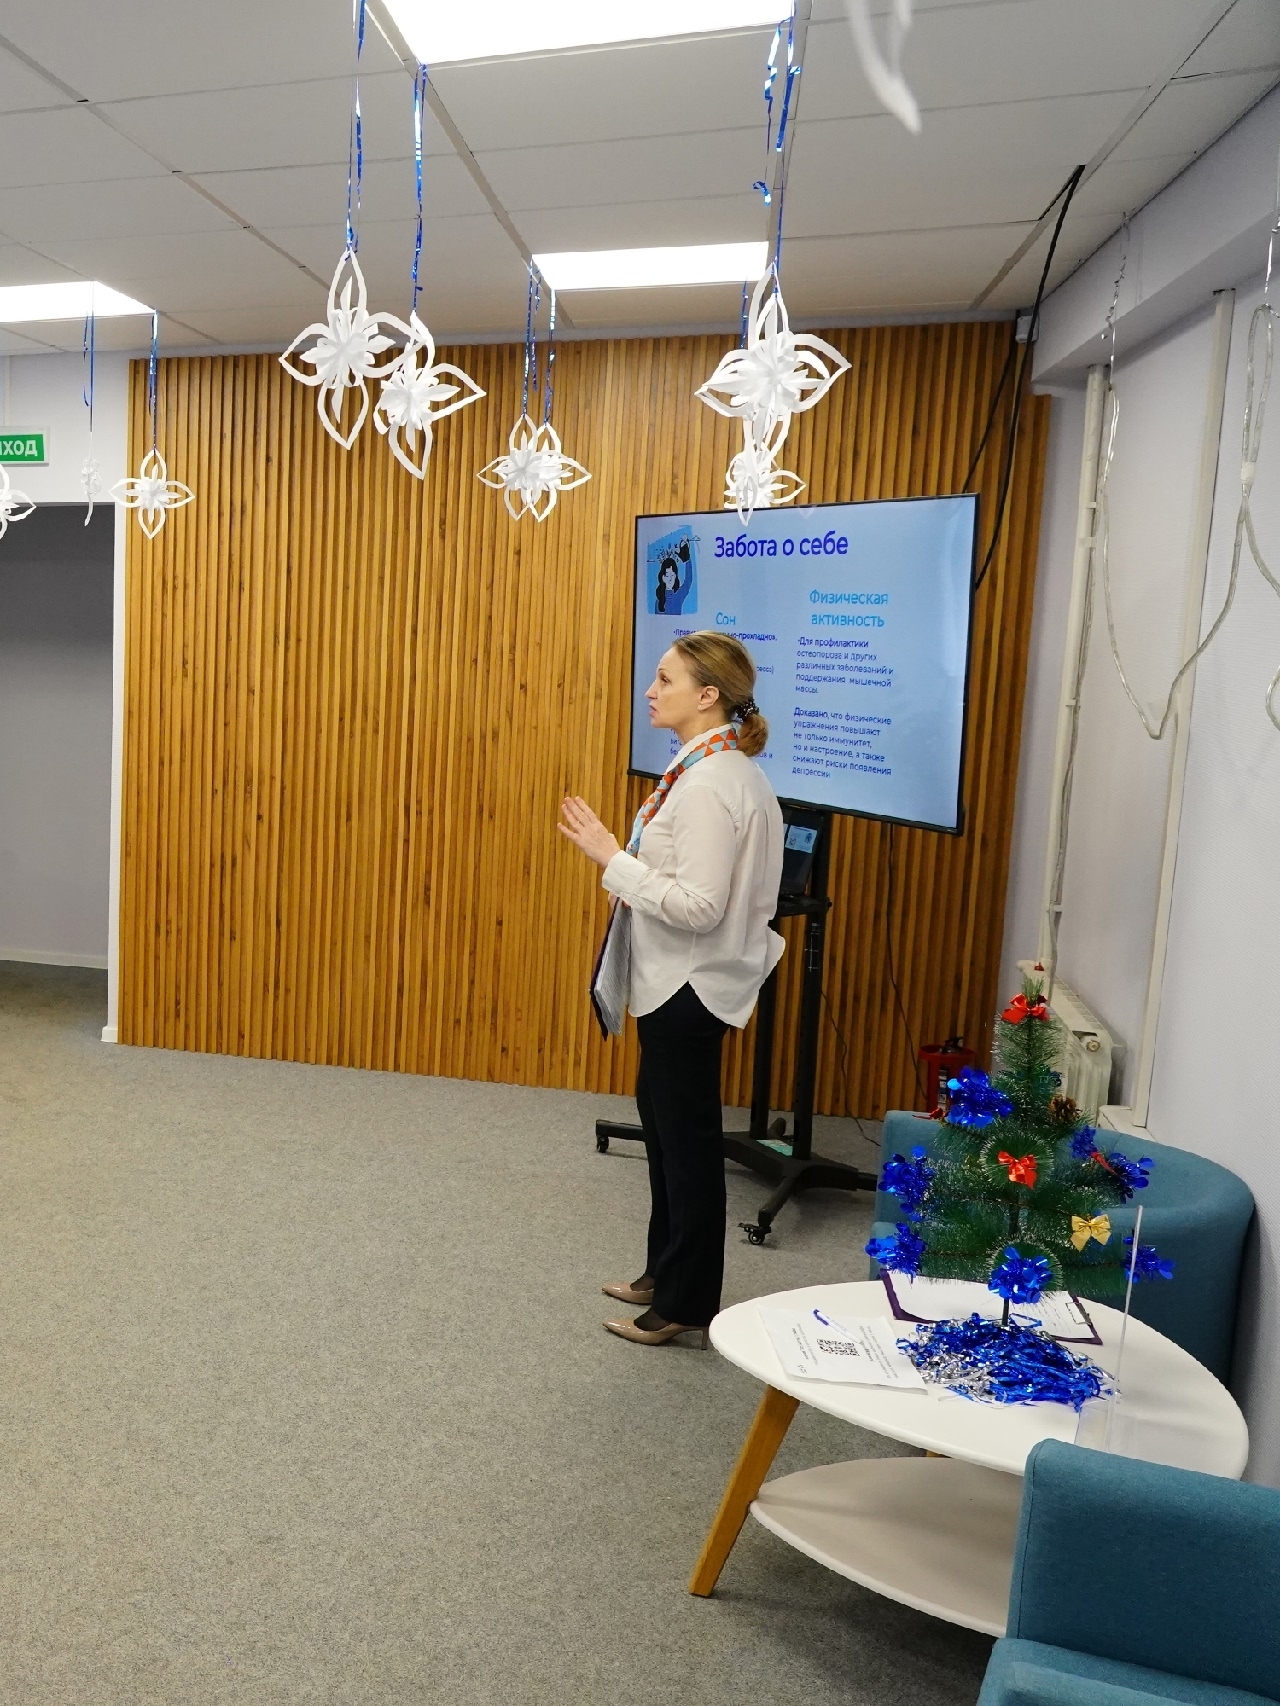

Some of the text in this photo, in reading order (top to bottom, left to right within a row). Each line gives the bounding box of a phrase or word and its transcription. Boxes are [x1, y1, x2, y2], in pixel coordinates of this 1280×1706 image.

[714, 530, 849, 558] Забота о себе
[809, 589, 889, 605] Физическая
[715, 612, 737, 626] Сон
[811, 613, 885, 628] активность
[814, 637, 869, 649] профилактики
[796, 650, 878, 663] остеопороза и других
[796, 662, 836, 671] различных
[837, 663, 887, 675] заболеваний
[795, 673, 892, 688] поддержания мышечной
[793, 706, 892, 726] Доказано, что физические
[793, 720, 882, 737] упражнения повышают
[793, 732, 802, 740] не
[804, 733, 828, 742] только
[862, 752, 886, 763] также
[792, 755, 892, 776] снижают риски появления
